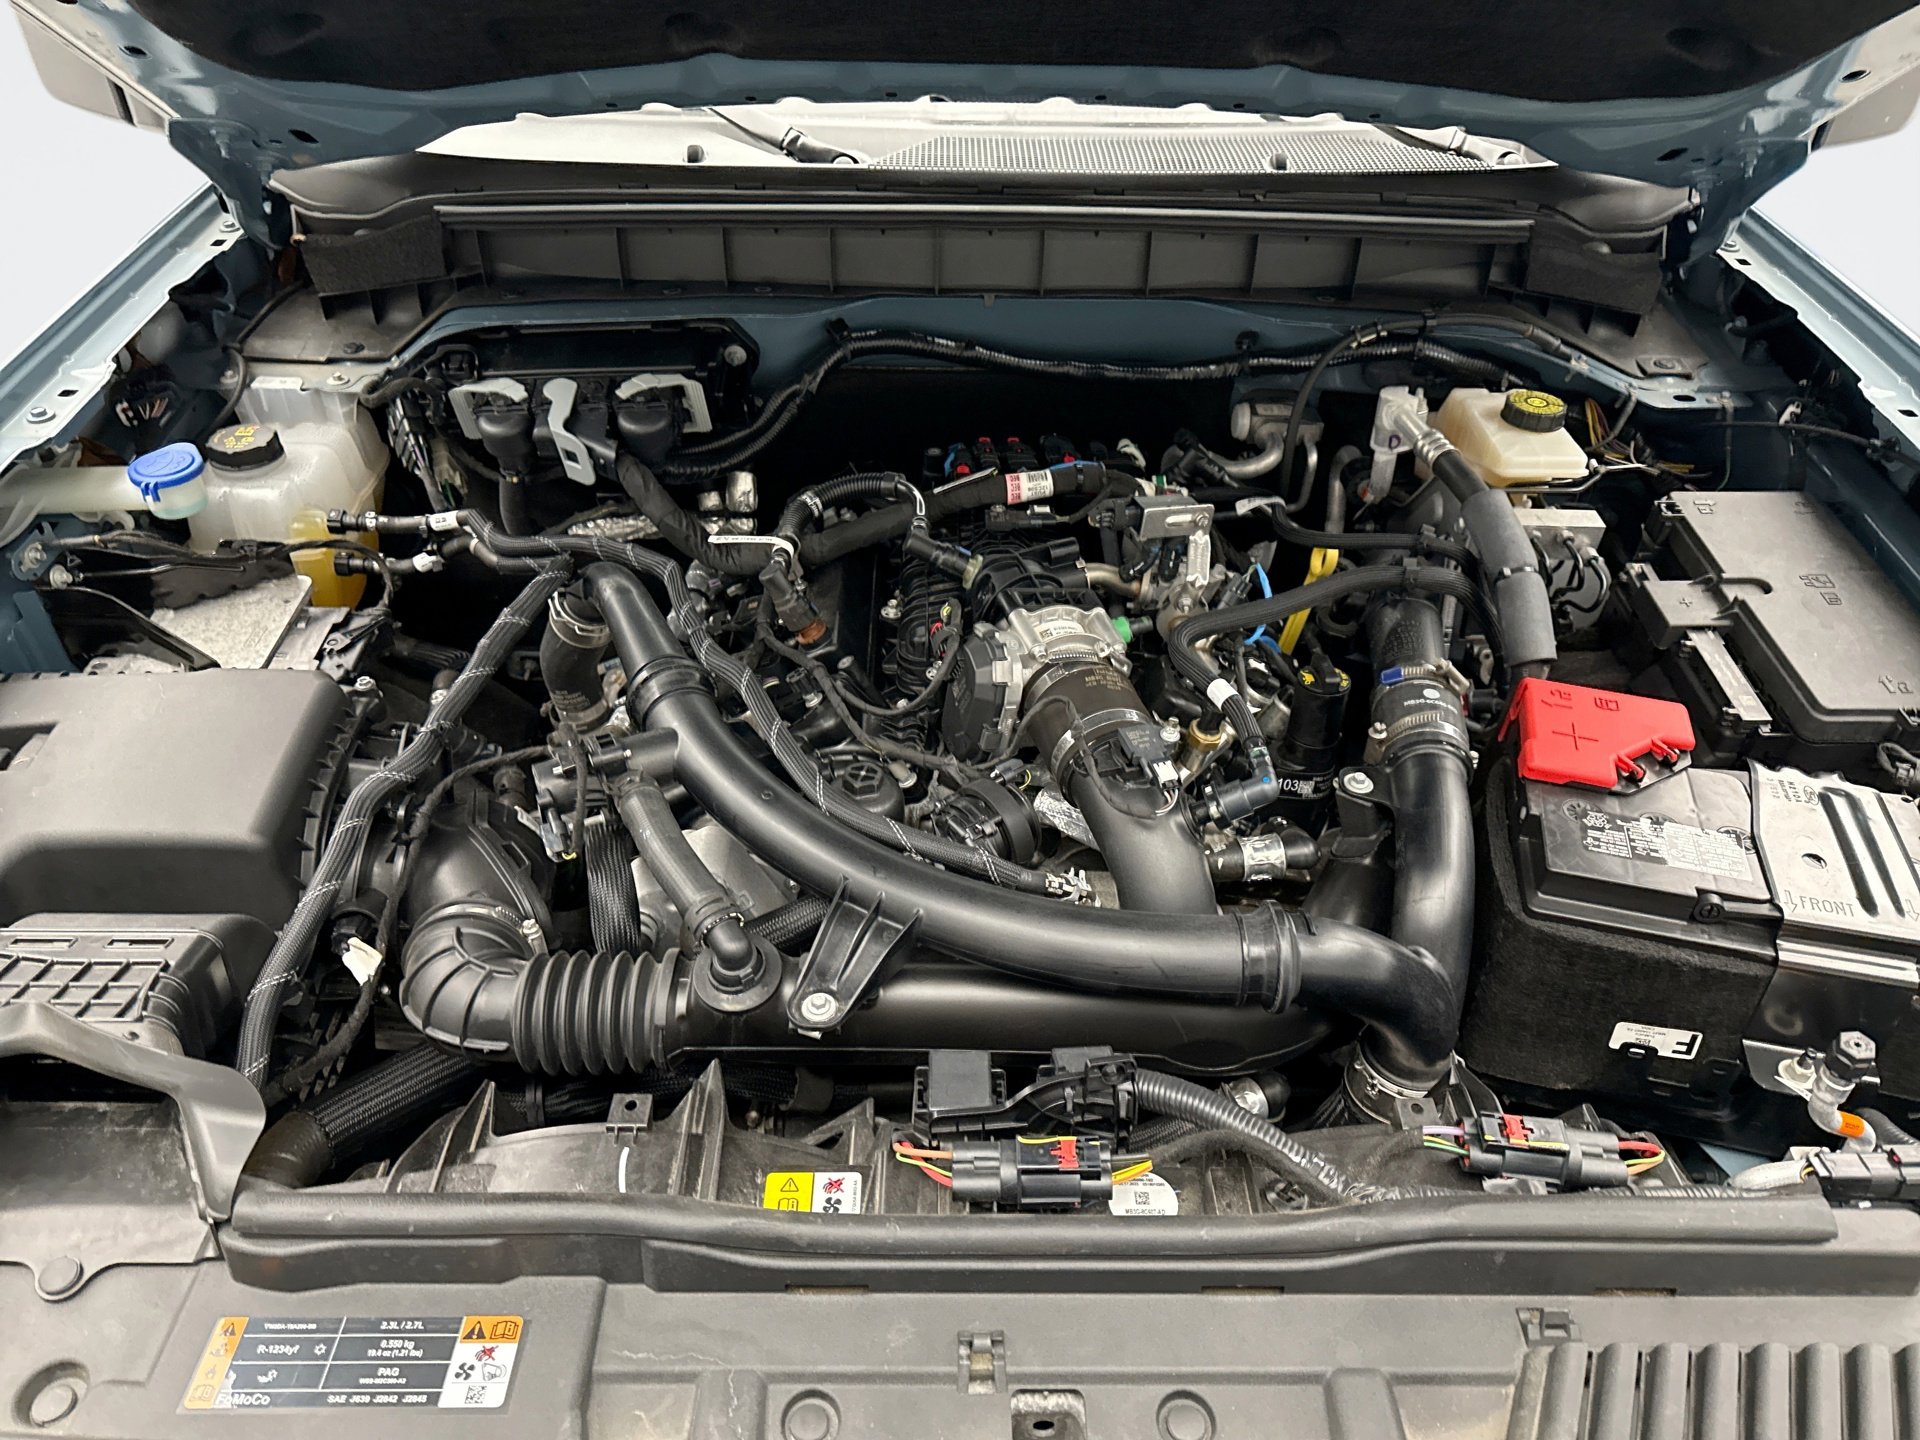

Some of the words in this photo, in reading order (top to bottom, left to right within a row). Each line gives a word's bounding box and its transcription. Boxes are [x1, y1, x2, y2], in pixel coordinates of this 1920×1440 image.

[1278, 778, 1299, 791] 103
[1799, 895, 1855, 918] FRONT
[1671, 1033, 1700, 1056] F
[380, 1321, 400, 1329] 2.3L
[405, 1321, 424, 1329] 2.7L
[256, 1344, 301, 1355] R-1234yf
[380, 1340, 402, 1348] 0.550
[403, 1340, 415, 1349] kg
[391, 1349, 408, 1358] (1.21
[377, 1367, 400, 1376] PAG
[215, 1393, 271, 1405] FoMoCo
[327, 1395, 347, 1403] SAE
[349, 1395, 371, 1403] J639
[372, 1395, 398, 1403] J2842
[402, 1395, 428, 1403] J2845
